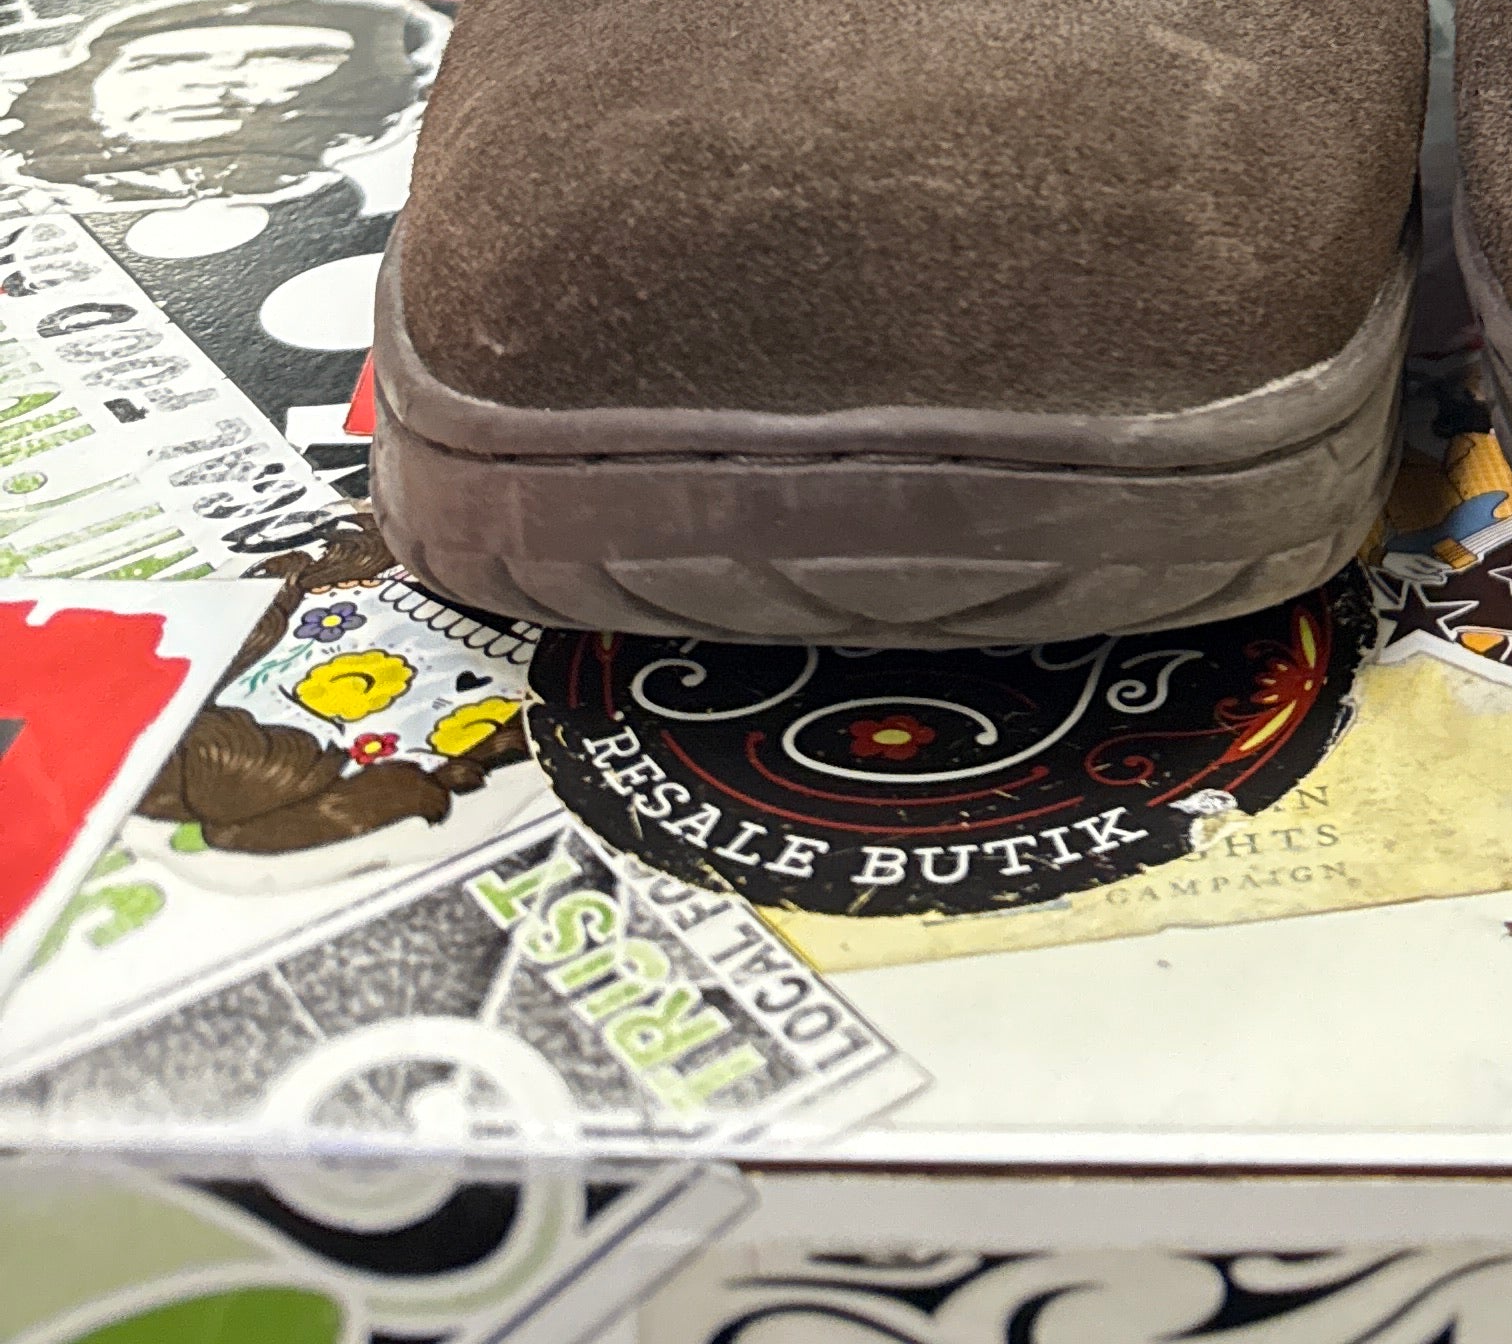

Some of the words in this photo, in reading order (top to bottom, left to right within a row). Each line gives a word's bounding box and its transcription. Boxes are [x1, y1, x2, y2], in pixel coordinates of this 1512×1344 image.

[582, 725, 831, 879] RESALE
[850, 805, 1149, 885] BUTIK
[463, 852, 770, 1124] TRUST
[711, 921, 874, 1074] LOCAL
